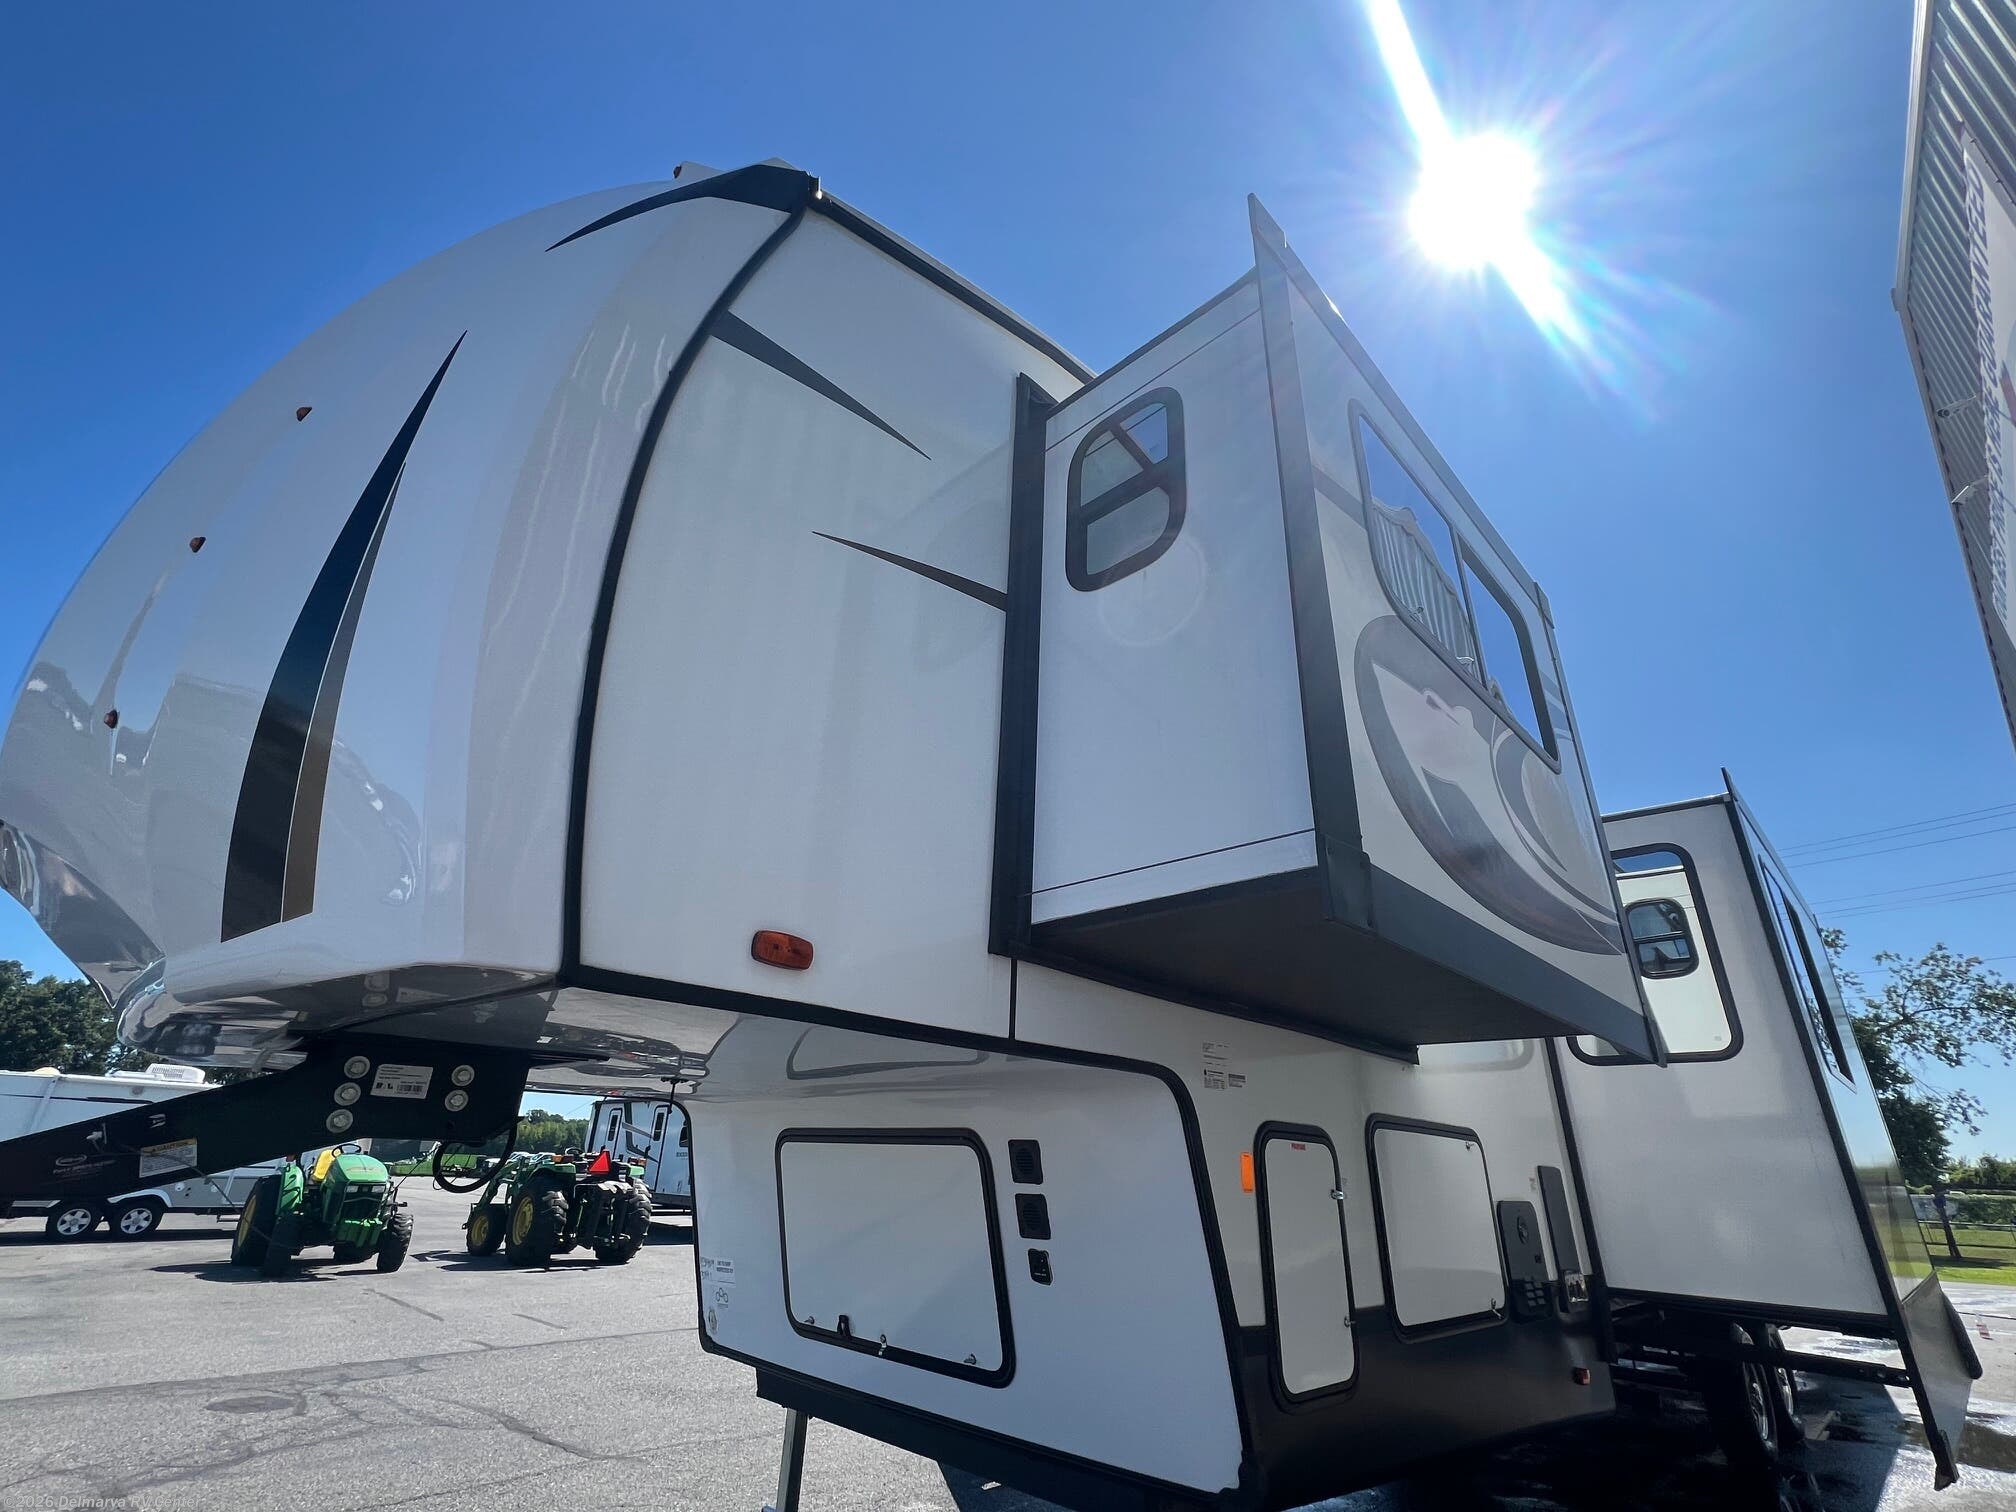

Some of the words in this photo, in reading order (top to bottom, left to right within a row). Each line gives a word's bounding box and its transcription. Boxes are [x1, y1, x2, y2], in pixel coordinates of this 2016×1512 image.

[1966, 164, 1998, 388] GUARANTEED
[1981, 377, 2002, 458] HERE
[1986, 442, 2004, 484] IS
